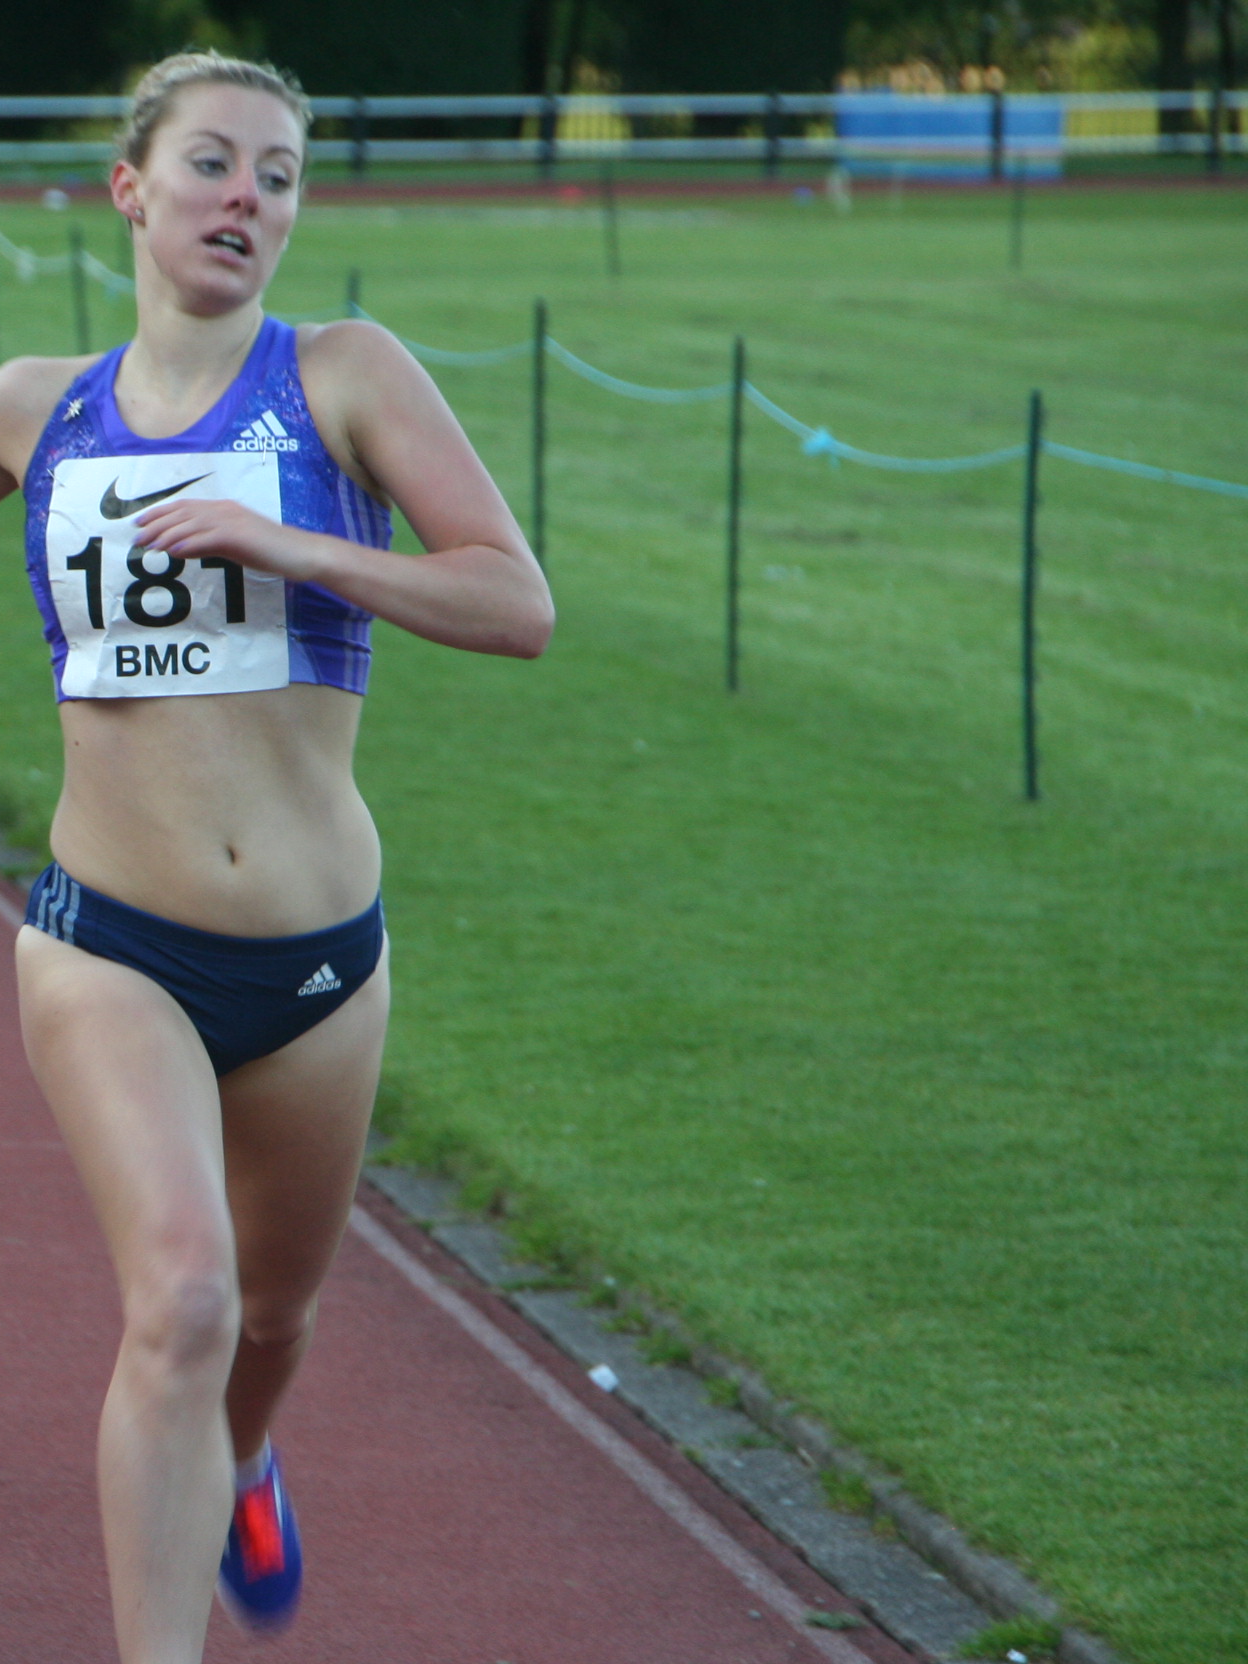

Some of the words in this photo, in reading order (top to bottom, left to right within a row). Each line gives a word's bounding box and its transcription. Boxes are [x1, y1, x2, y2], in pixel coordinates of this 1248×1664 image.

[233, 436, 298, 452] adidas
[66, 536, 247, 630] 181
[115, 642, 211, 678] BMC
[297, 978, 342, 997] adidas
